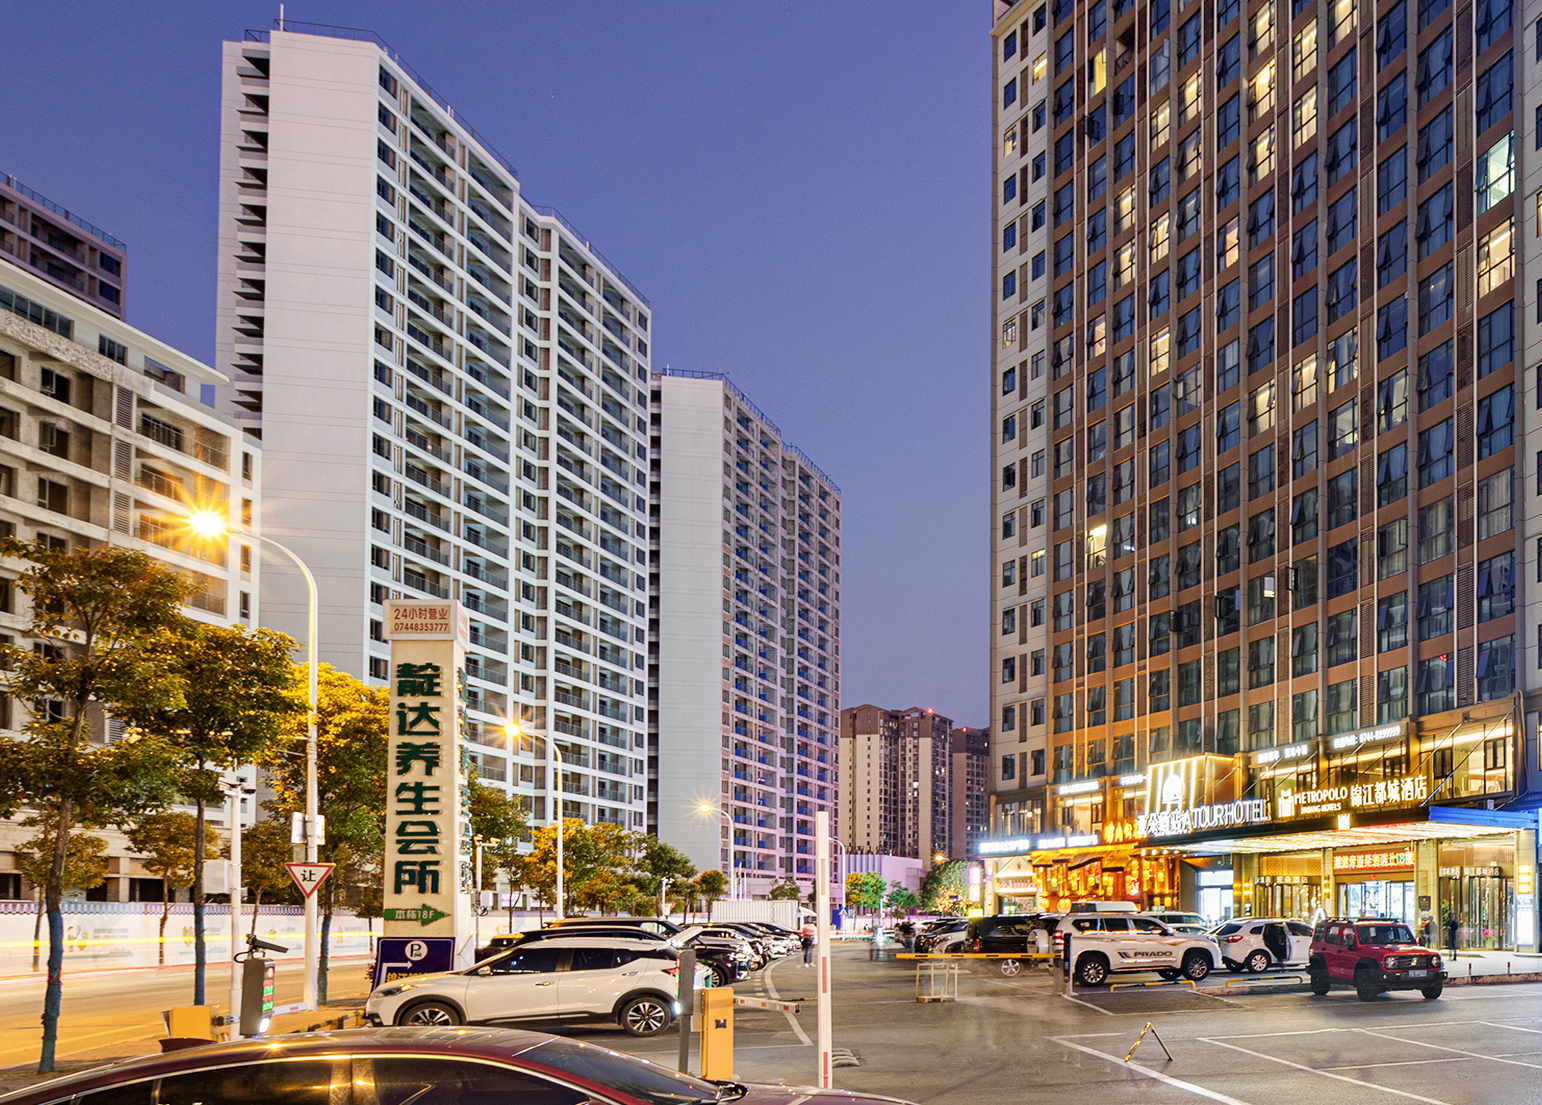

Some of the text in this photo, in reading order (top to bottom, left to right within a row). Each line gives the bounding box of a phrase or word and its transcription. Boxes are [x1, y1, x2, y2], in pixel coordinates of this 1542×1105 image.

[394, 608, 448, 620] 24小时营业
[394, 623, 448, 631] 07448353777
[395, 662, 441, 894] 靛达养生会所
[1294, 786, 1348, 805] METROPOLO
[1350, 774, 1428, 807] 锦江都城酒店
[1136, 807, 1182, 838] 亚朵酒店
[301, 870, 316, 882] 让
[395, 910, 434, 919] 本栋18F
